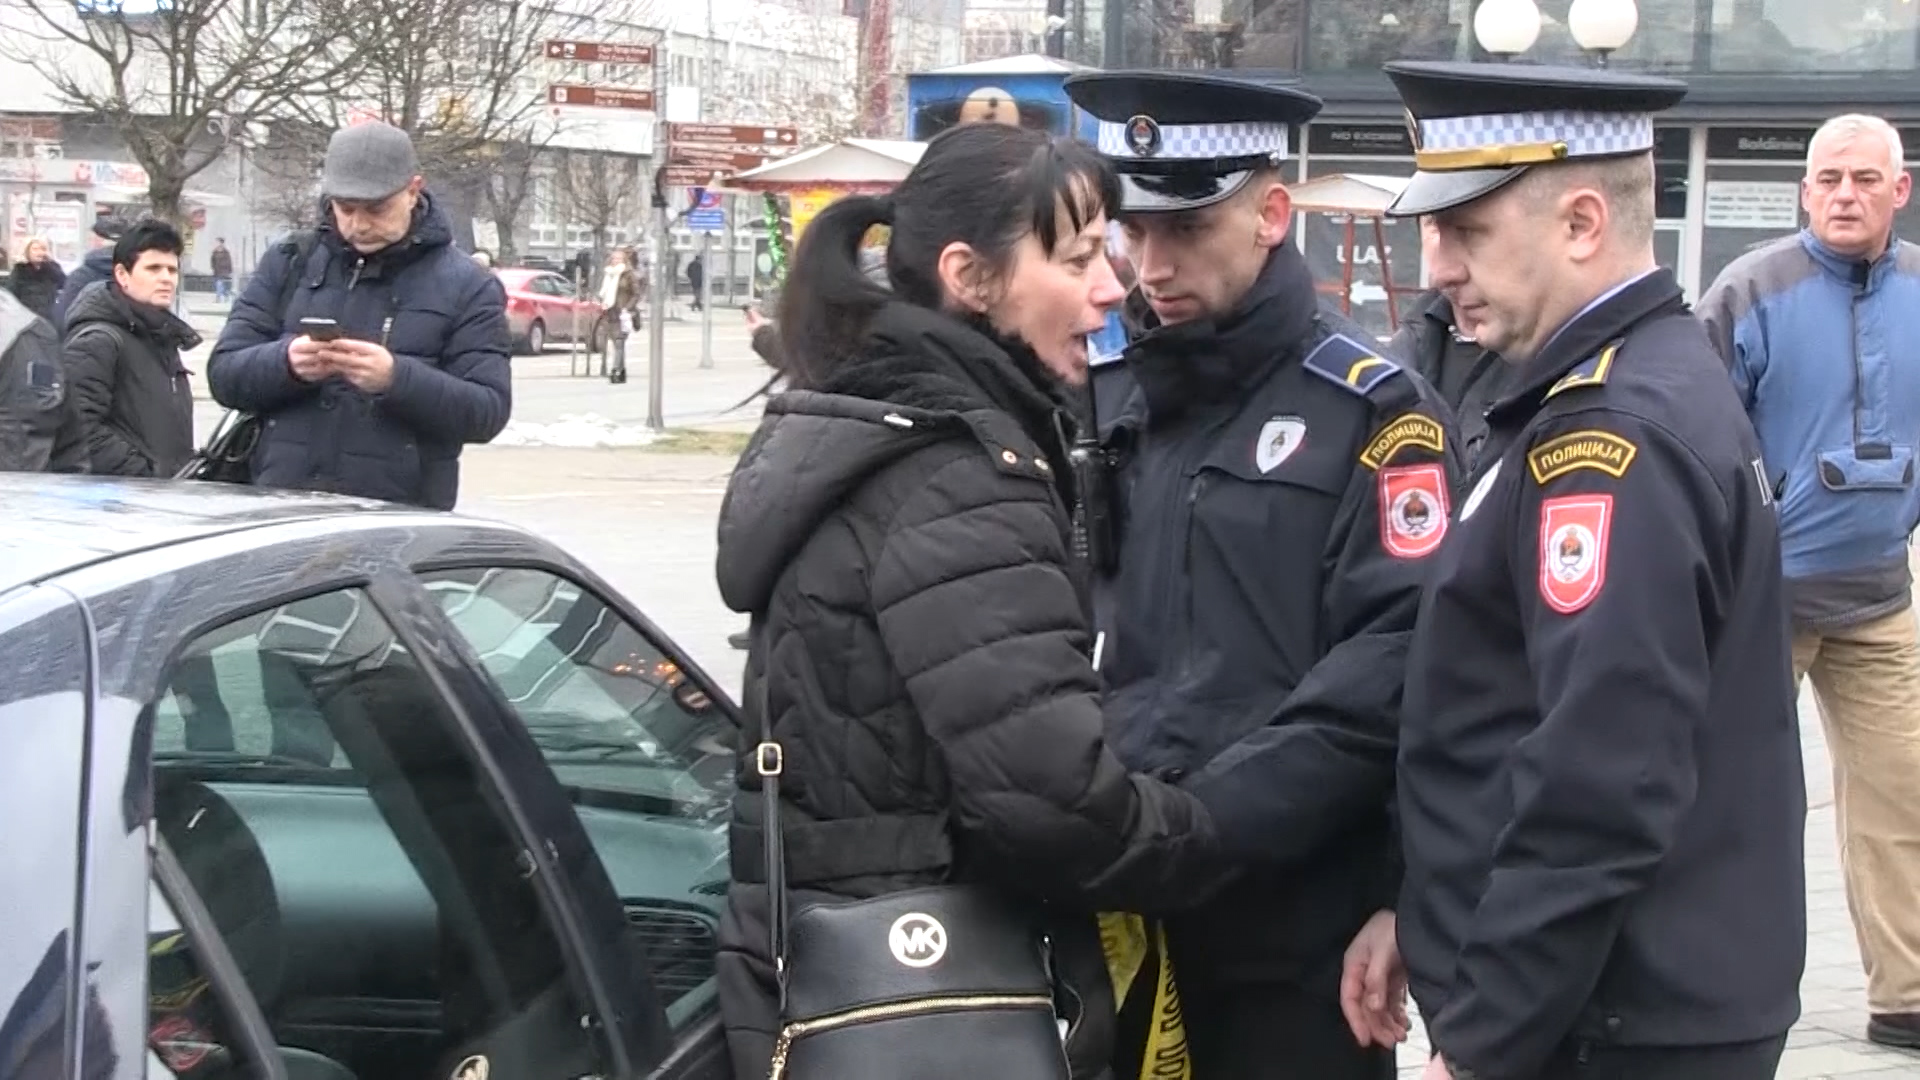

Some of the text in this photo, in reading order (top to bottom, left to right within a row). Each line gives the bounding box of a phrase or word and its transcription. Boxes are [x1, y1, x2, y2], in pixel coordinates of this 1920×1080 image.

[1371, 423, 1437, 460] ПОЛИЦИЈА
[1541, 441, 1623, 470] ПОЛИЦИЈА
[894, 920, 944, 960] MK
